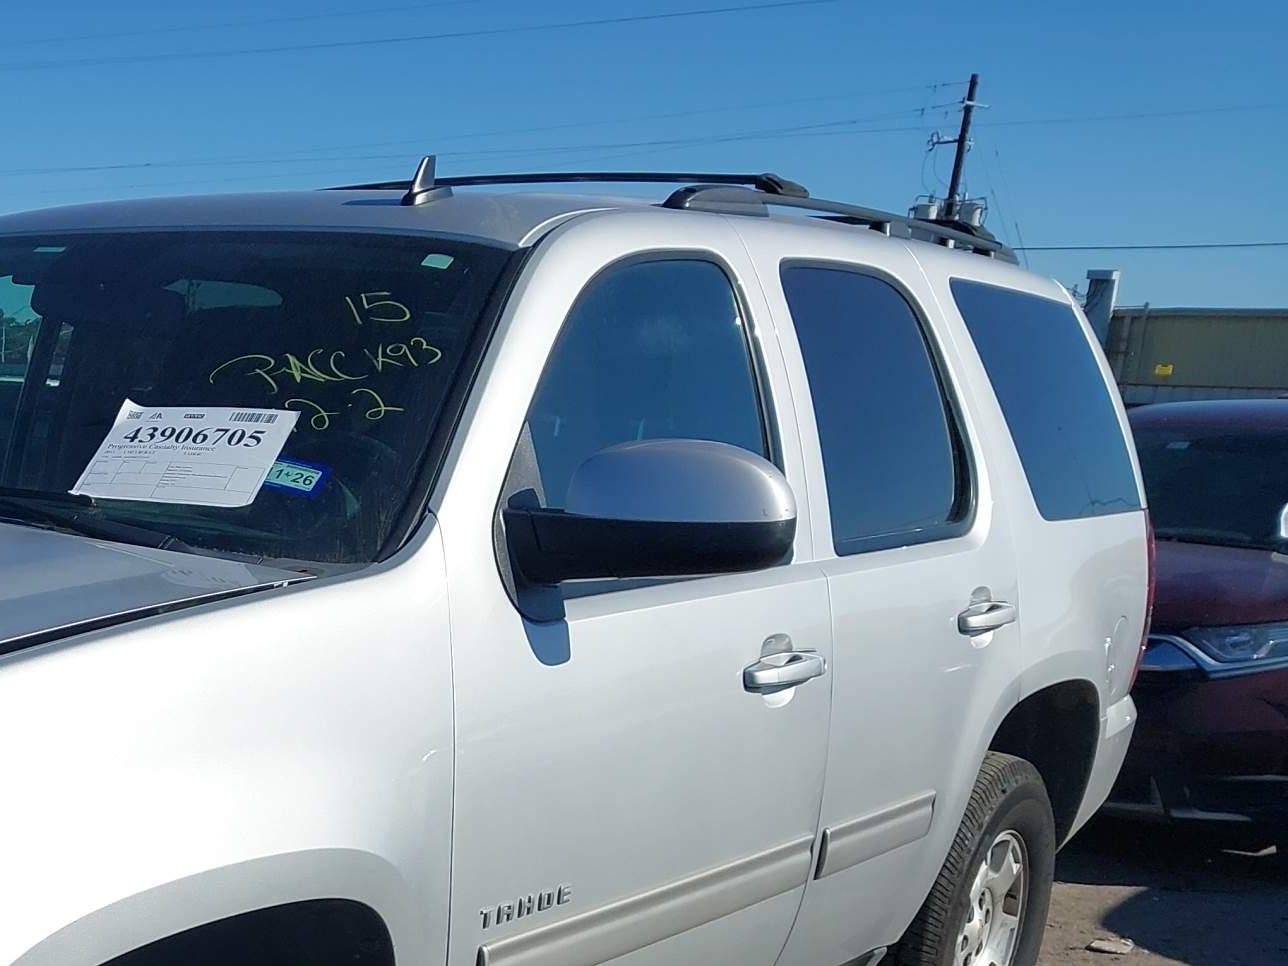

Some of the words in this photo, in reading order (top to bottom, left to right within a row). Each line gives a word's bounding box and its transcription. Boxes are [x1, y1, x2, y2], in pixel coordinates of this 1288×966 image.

[345, 291, 411, 325] 15
[123, 425, 267, 448] 43906705
[291, 473, 314, 486] 26
[479, 884, 572, 929] TAHOE
